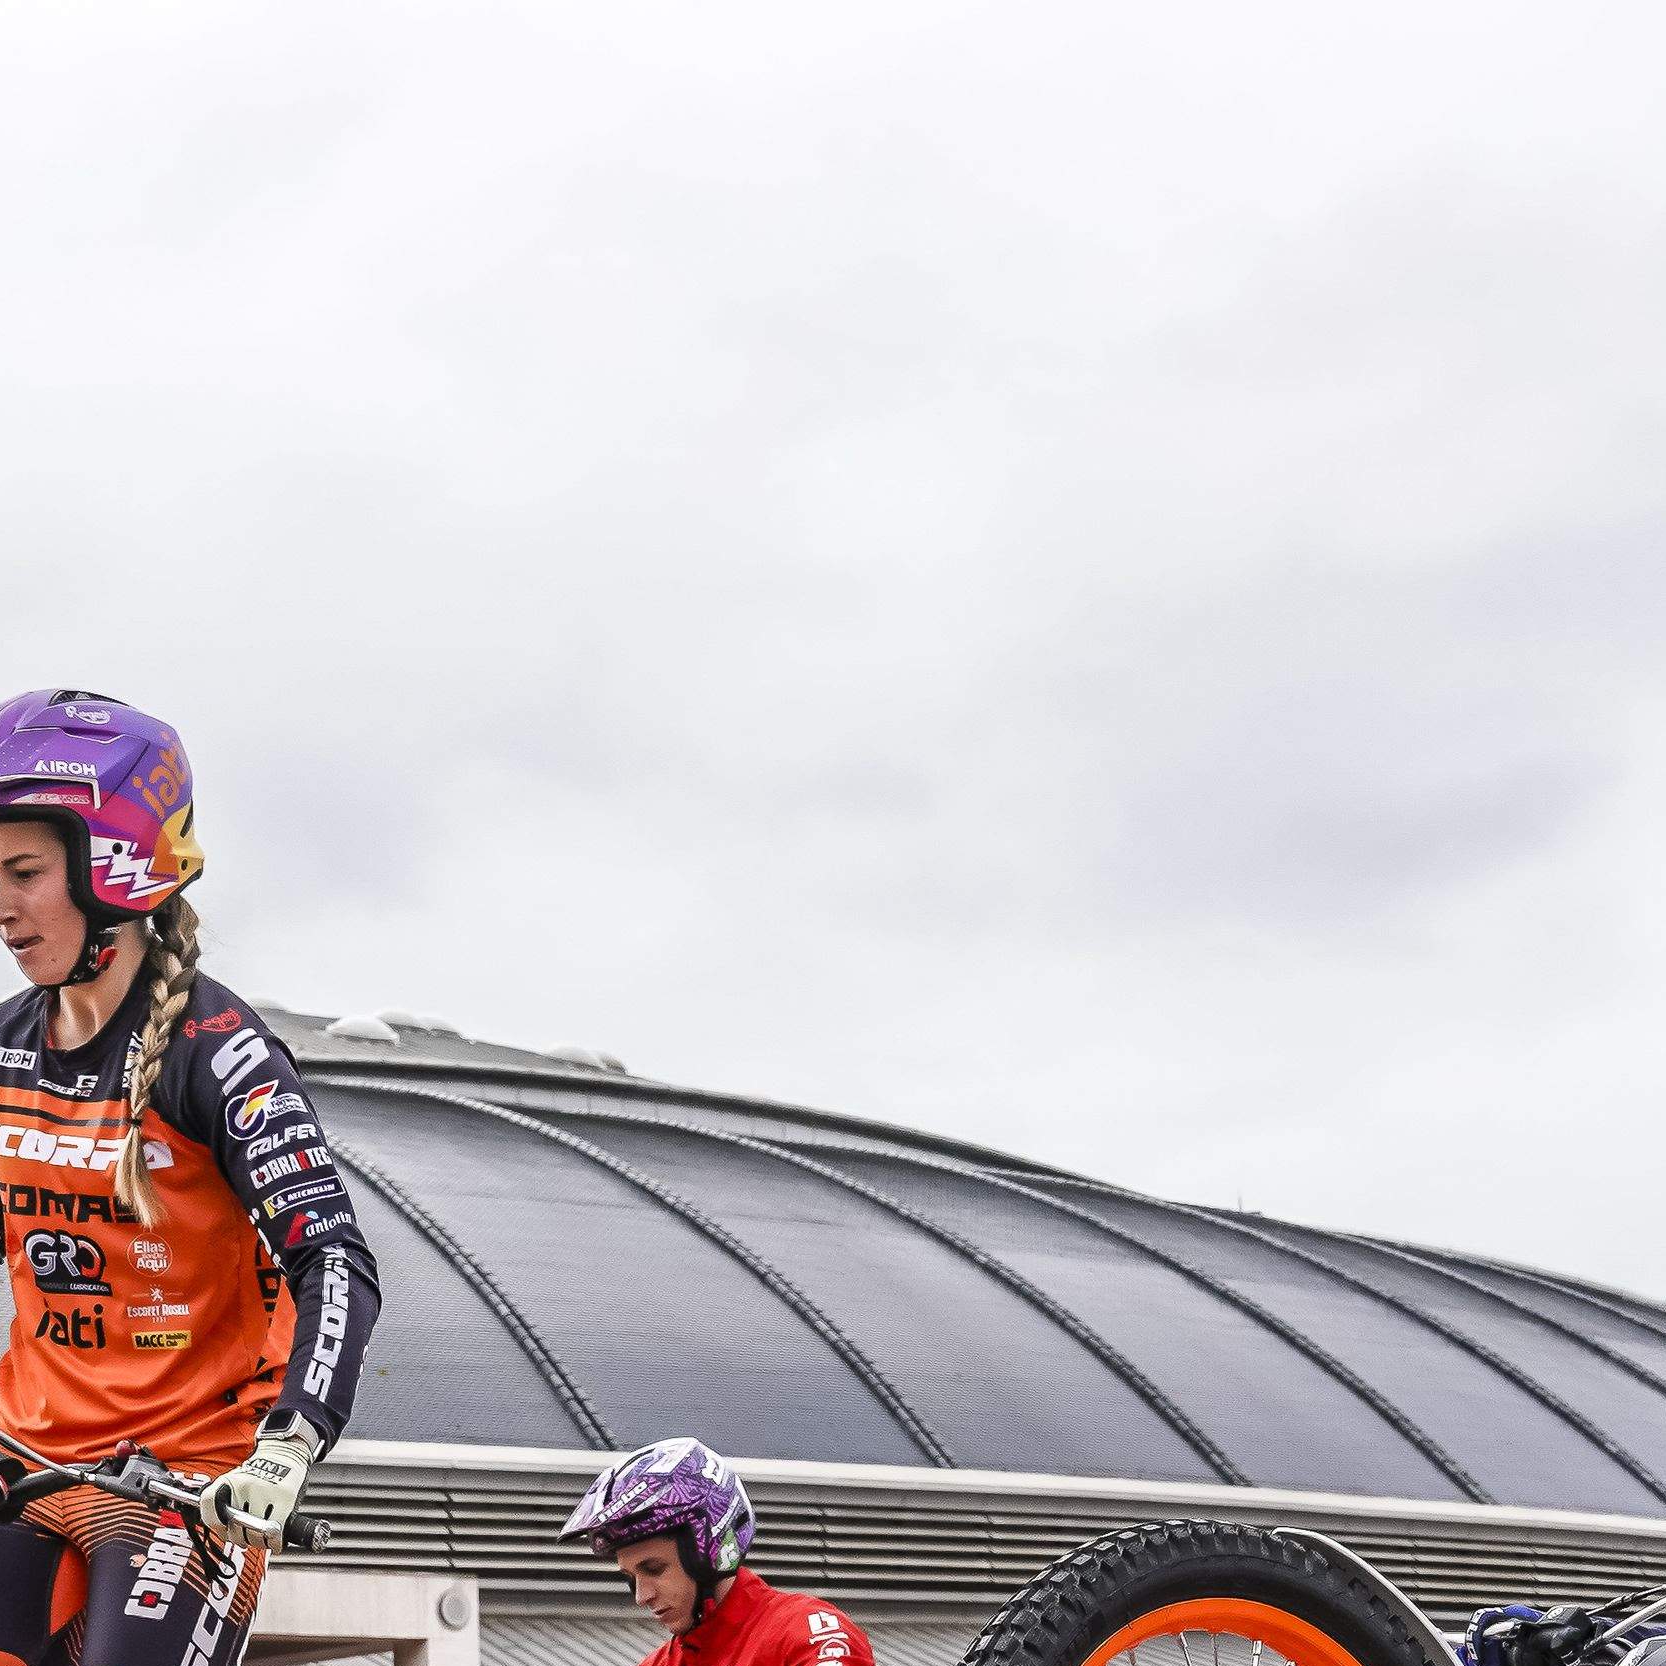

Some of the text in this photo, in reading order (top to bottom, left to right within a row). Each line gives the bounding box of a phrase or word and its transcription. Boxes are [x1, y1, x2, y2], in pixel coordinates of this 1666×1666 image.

[34, 759, 97, 777] AIROH
[246, 1123, 318, 1161] GALFER
[133, 1240, 166, 1254] Ellas
